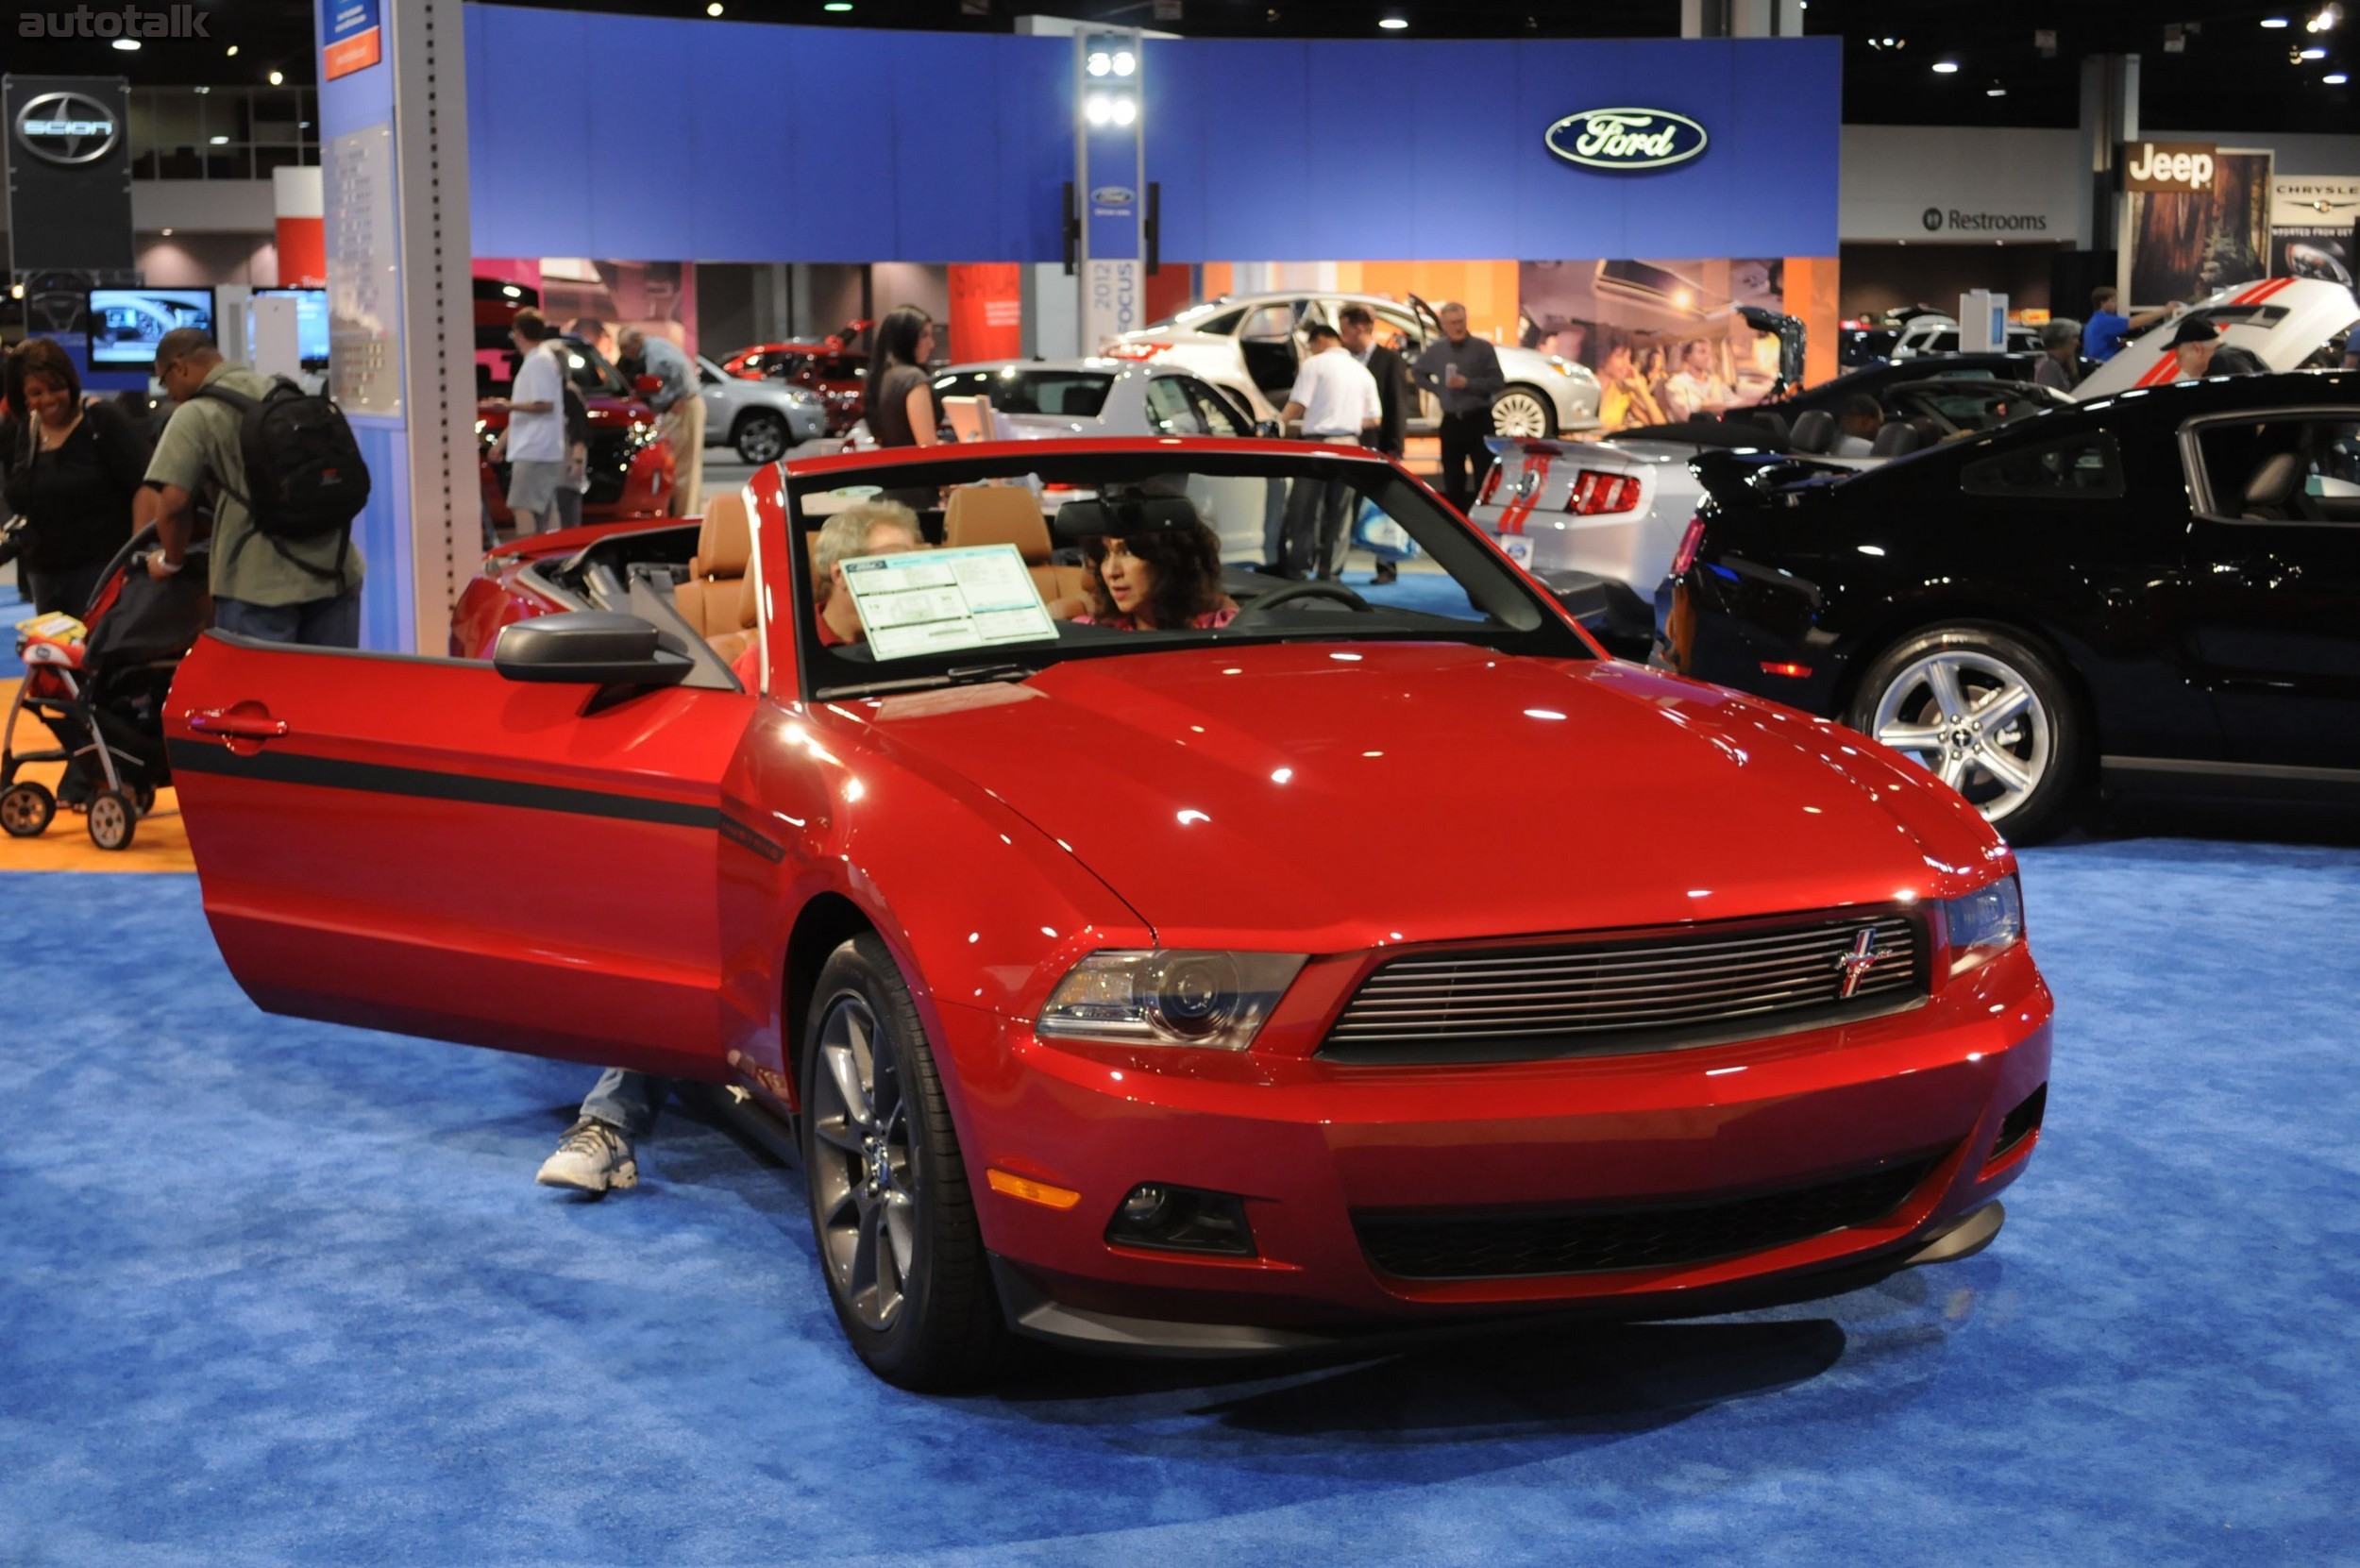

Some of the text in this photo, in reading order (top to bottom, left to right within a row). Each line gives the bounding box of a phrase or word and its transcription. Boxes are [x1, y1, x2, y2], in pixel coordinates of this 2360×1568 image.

[1576, 114, 1677, 157] Ford
[2129, 143, 2214, 190] Jeep
[1948, 209, 2047, 231] Restrooms
[1093, 262, 1111, 310] 2012
